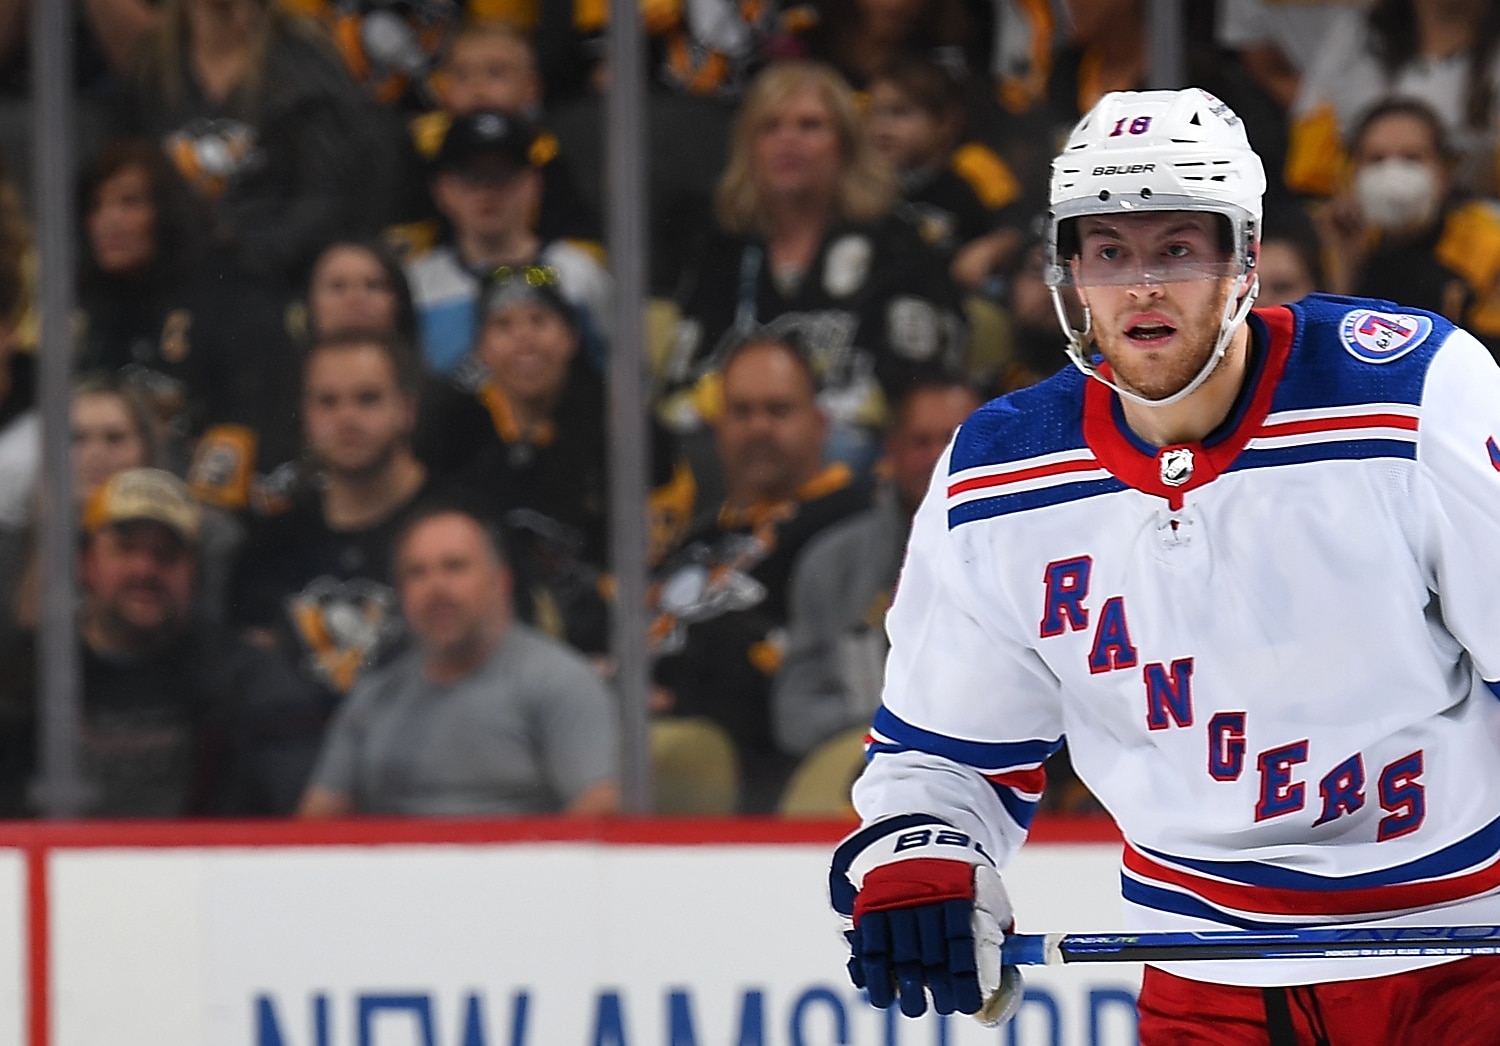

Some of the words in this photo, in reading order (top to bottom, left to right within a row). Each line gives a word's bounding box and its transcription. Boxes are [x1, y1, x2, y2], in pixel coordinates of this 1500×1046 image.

[1108, 116, 1153, 138] 18
[1092, 163, 1156, 176] BAUER
[1038, 553, 1428, 844] RANGERS
